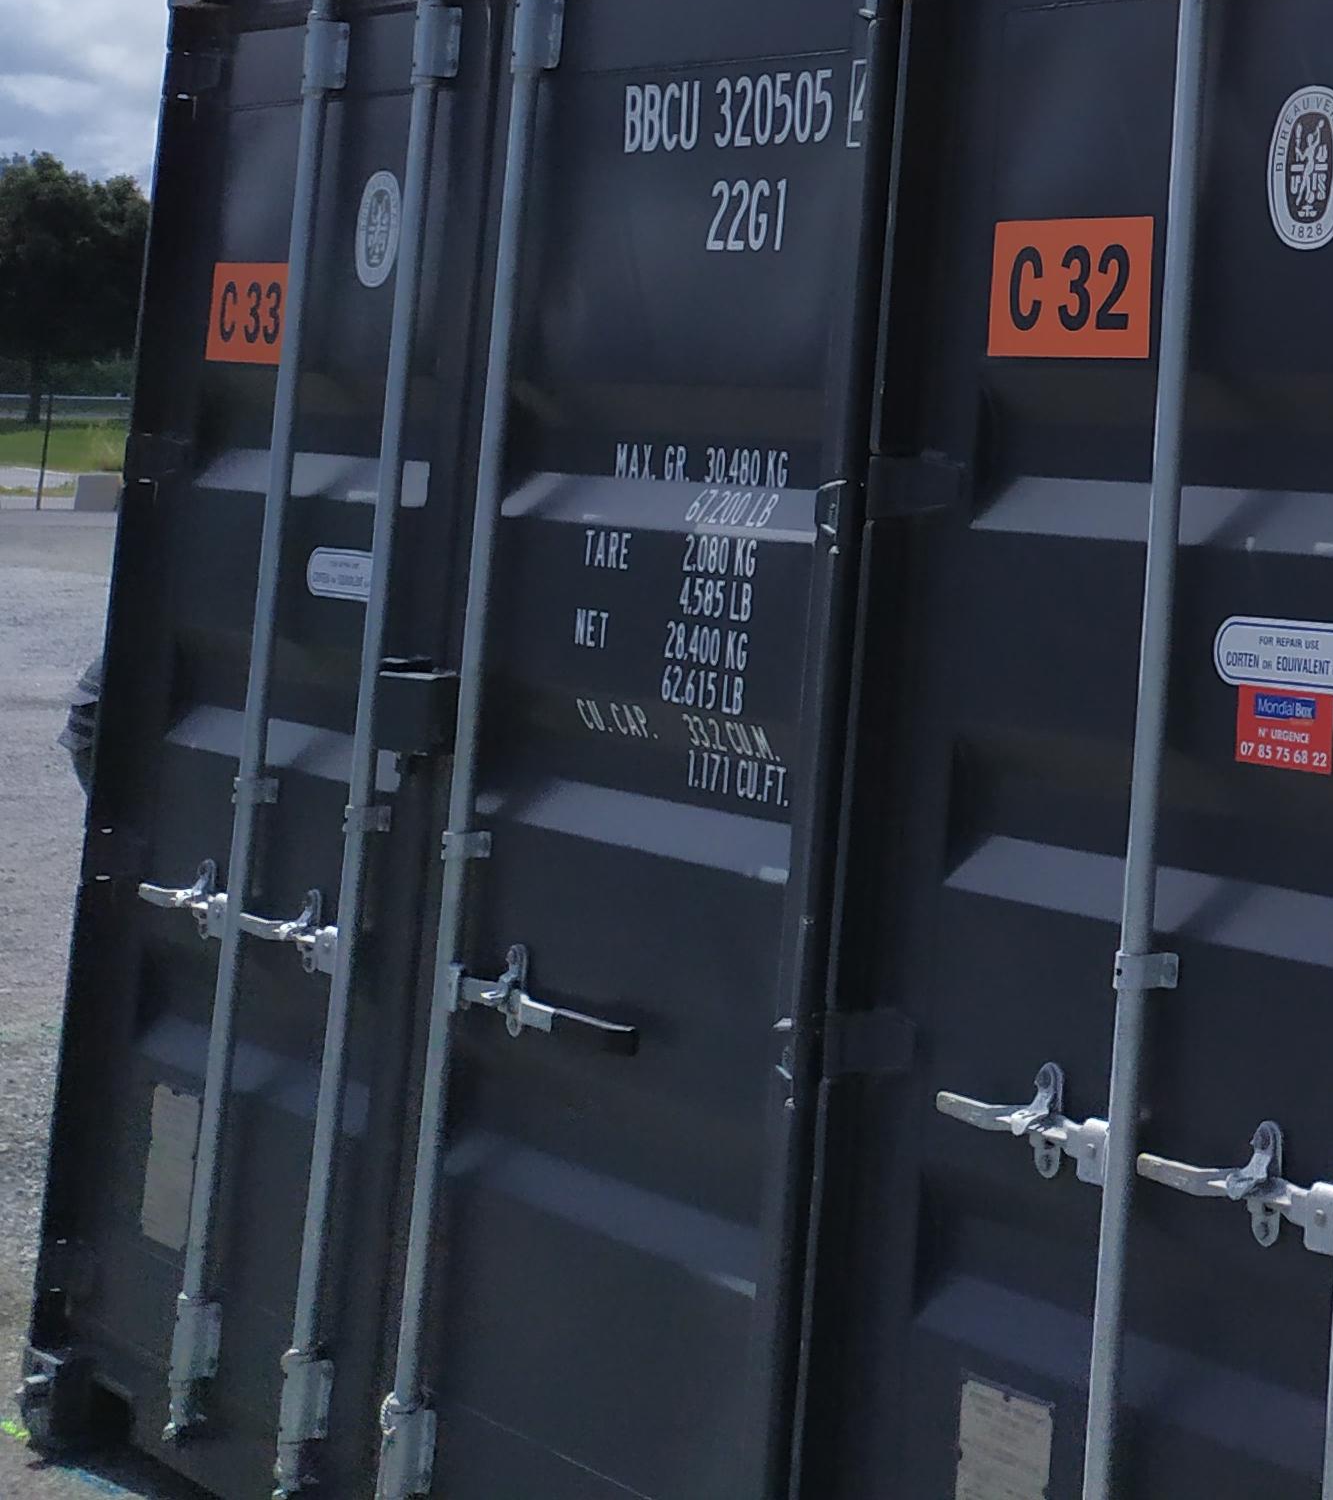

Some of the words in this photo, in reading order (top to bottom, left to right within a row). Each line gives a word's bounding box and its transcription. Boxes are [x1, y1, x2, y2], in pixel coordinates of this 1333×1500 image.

[624, 80, 700, 153] BBCU
[714, 69, 833, 148] 320505
[1275, 97, 1311, 172] BUREAU
[706, 178, 787, 251] 22G1
[1290, 223, 1323, 239] 1828
[1009, 245, 1043, 331] C
[1057, 243, 1130, 331] 32
[219, 281, 238, 343] C
[243, 282, 282, 345] 33
[615, 443, 656, 481] MAX.
[664, 445, 690, 482] GR.
[765, 450, 788, 488] KG
[745, 492, 779, 528] LB
[584, 529, 632, 570] TARE
[733, 538, 757, 578] KG
[729, 581, 752, 621] LB
[574, 608, 609, 649] NET
[724, 629, 748, 671] KG
[1258, 635, 1274, 646] FOR
[1276, 636, 1303, 649] REPAIR
[1304, 639, 1320, 651] USE
[1225, 651, 1260, 669] CORTEN
[1276, 655, 1331, 676] EQUIVALENT
[721, 674, 744, 715] LB
[1271, 729, 1309, 744] URGENCE
